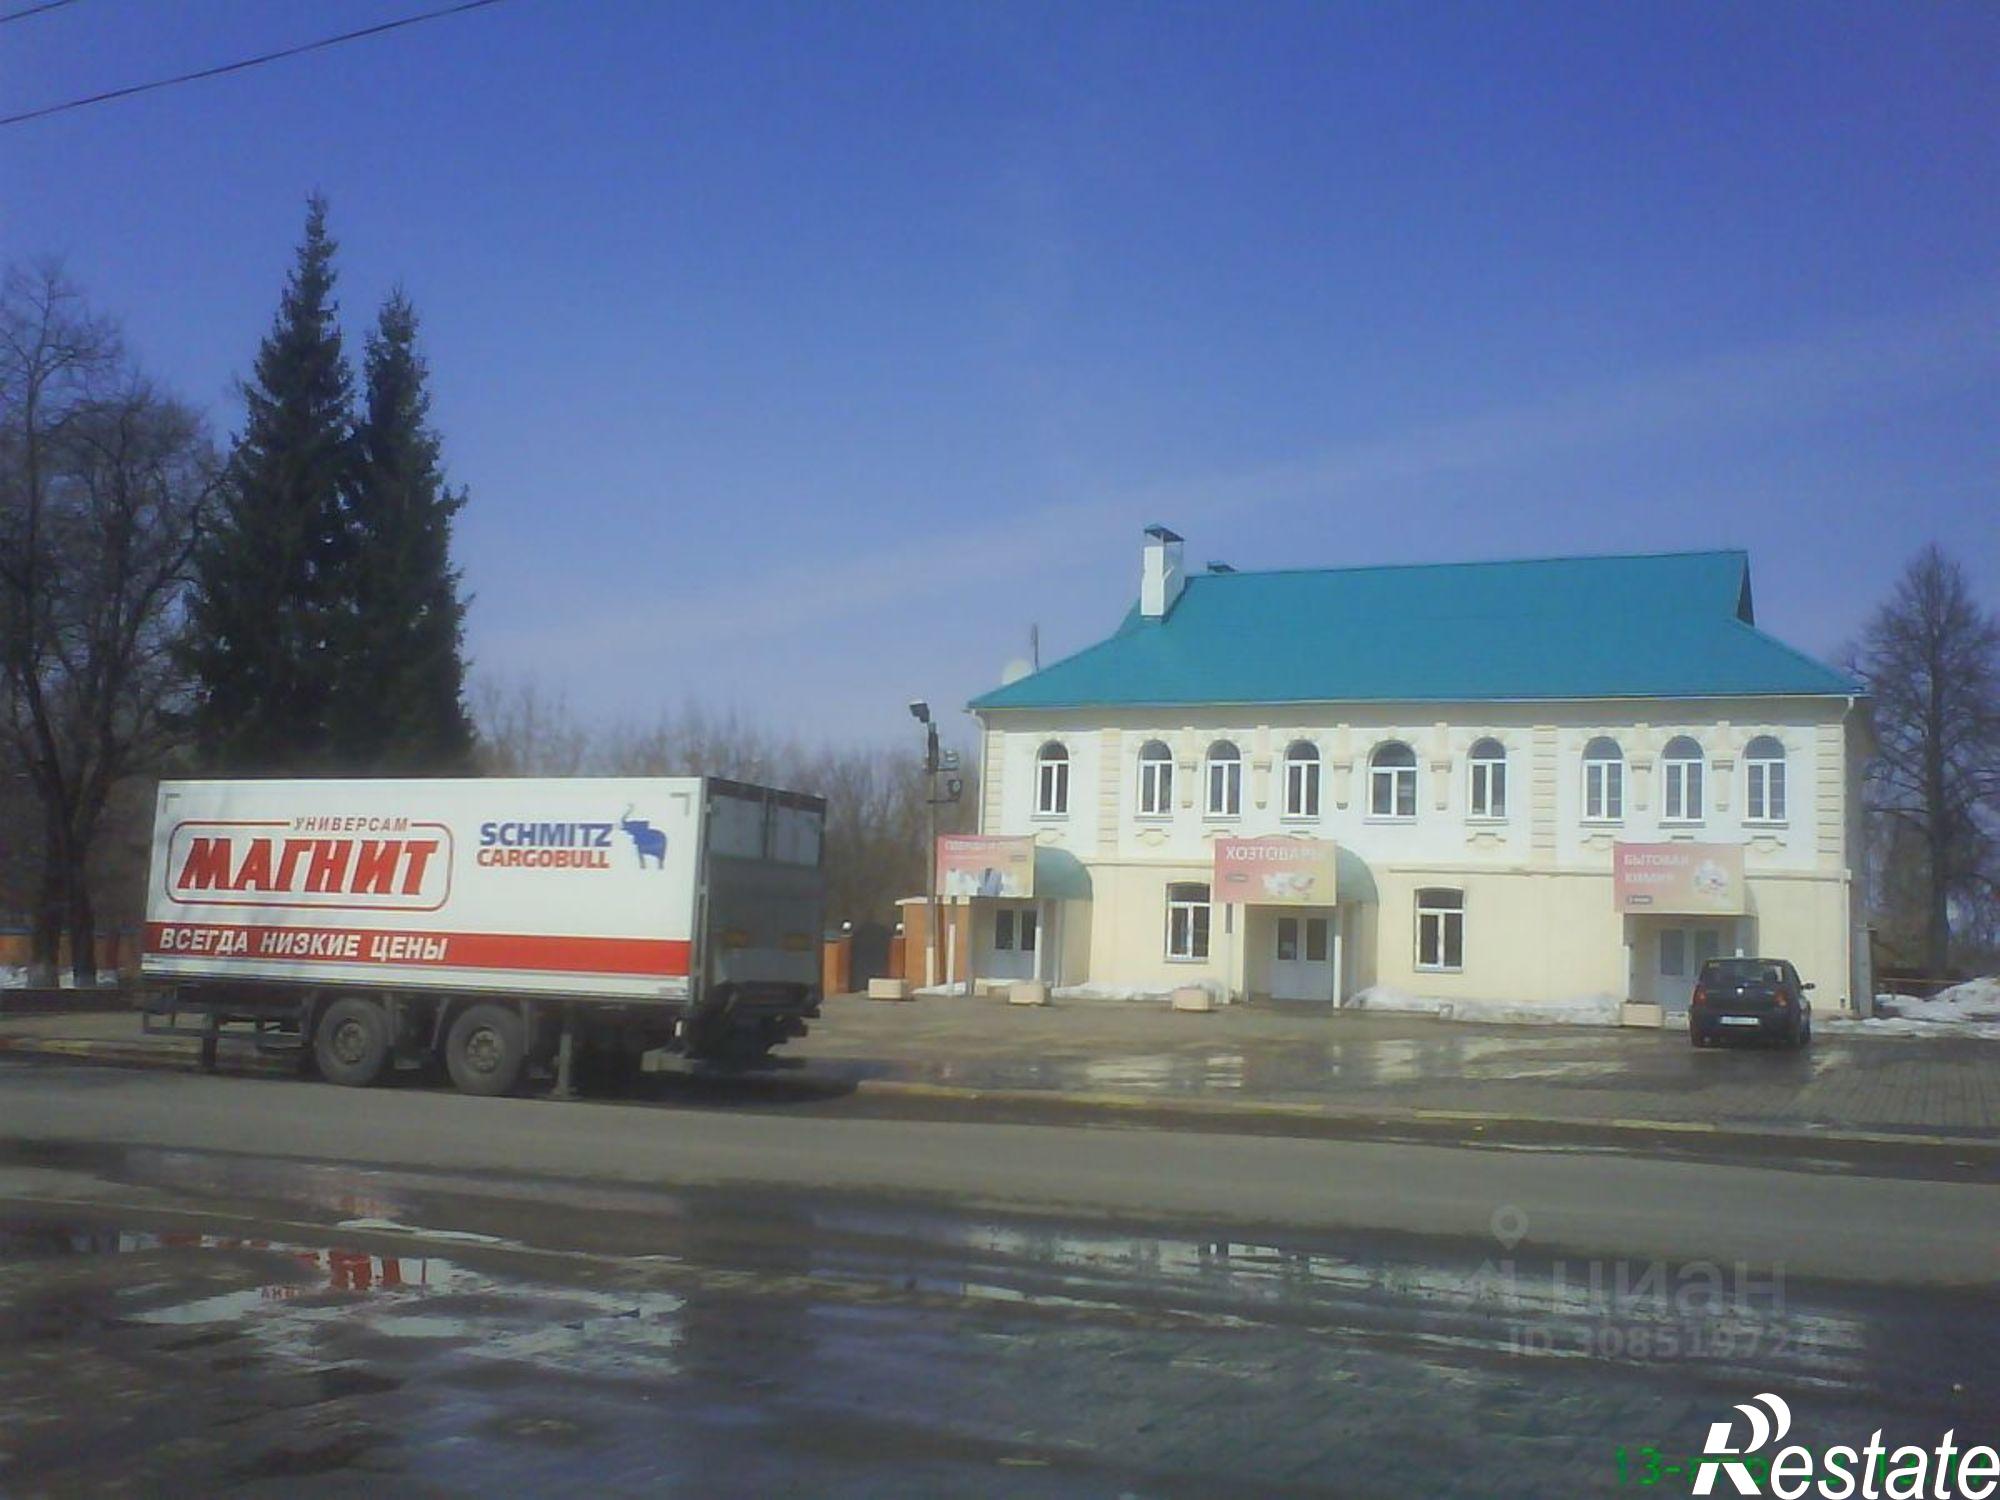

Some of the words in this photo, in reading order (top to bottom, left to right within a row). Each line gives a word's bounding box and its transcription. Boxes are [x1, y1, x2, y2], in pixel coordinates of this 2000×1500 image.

[293, 816, 409, 832] УНИВЕРСАМ
[480, 822, 614, 847] SCHMITZ
[176, 837, 440, 896] МАГНИТ
[477, 849, 610, 869] CARGOBULL
[159, 928, 248, 954] ВСЕГДА
[260, 932, 360, 956] НИЗКИЕ
[370, 936, 448, 961] ЦЕНЫ
